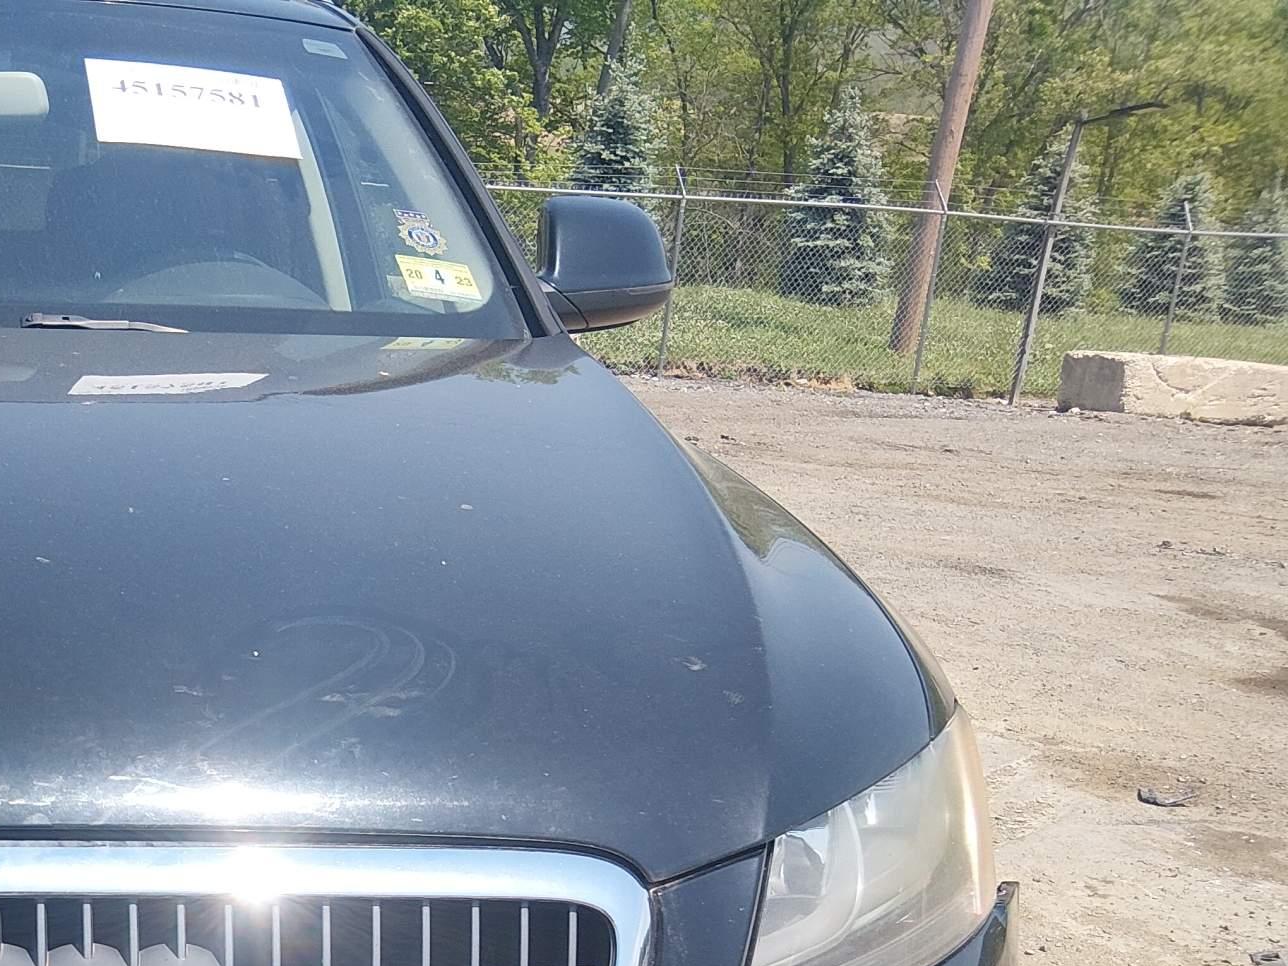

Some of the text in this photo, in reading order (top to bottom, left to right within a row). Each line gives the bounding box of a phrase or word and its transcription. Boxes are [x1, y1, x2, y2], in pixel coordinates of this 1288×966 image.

[113, 80, 261, 108] 45157581
[406, 268, 423, 280] 20
[434, 269, 445, 285] 4
